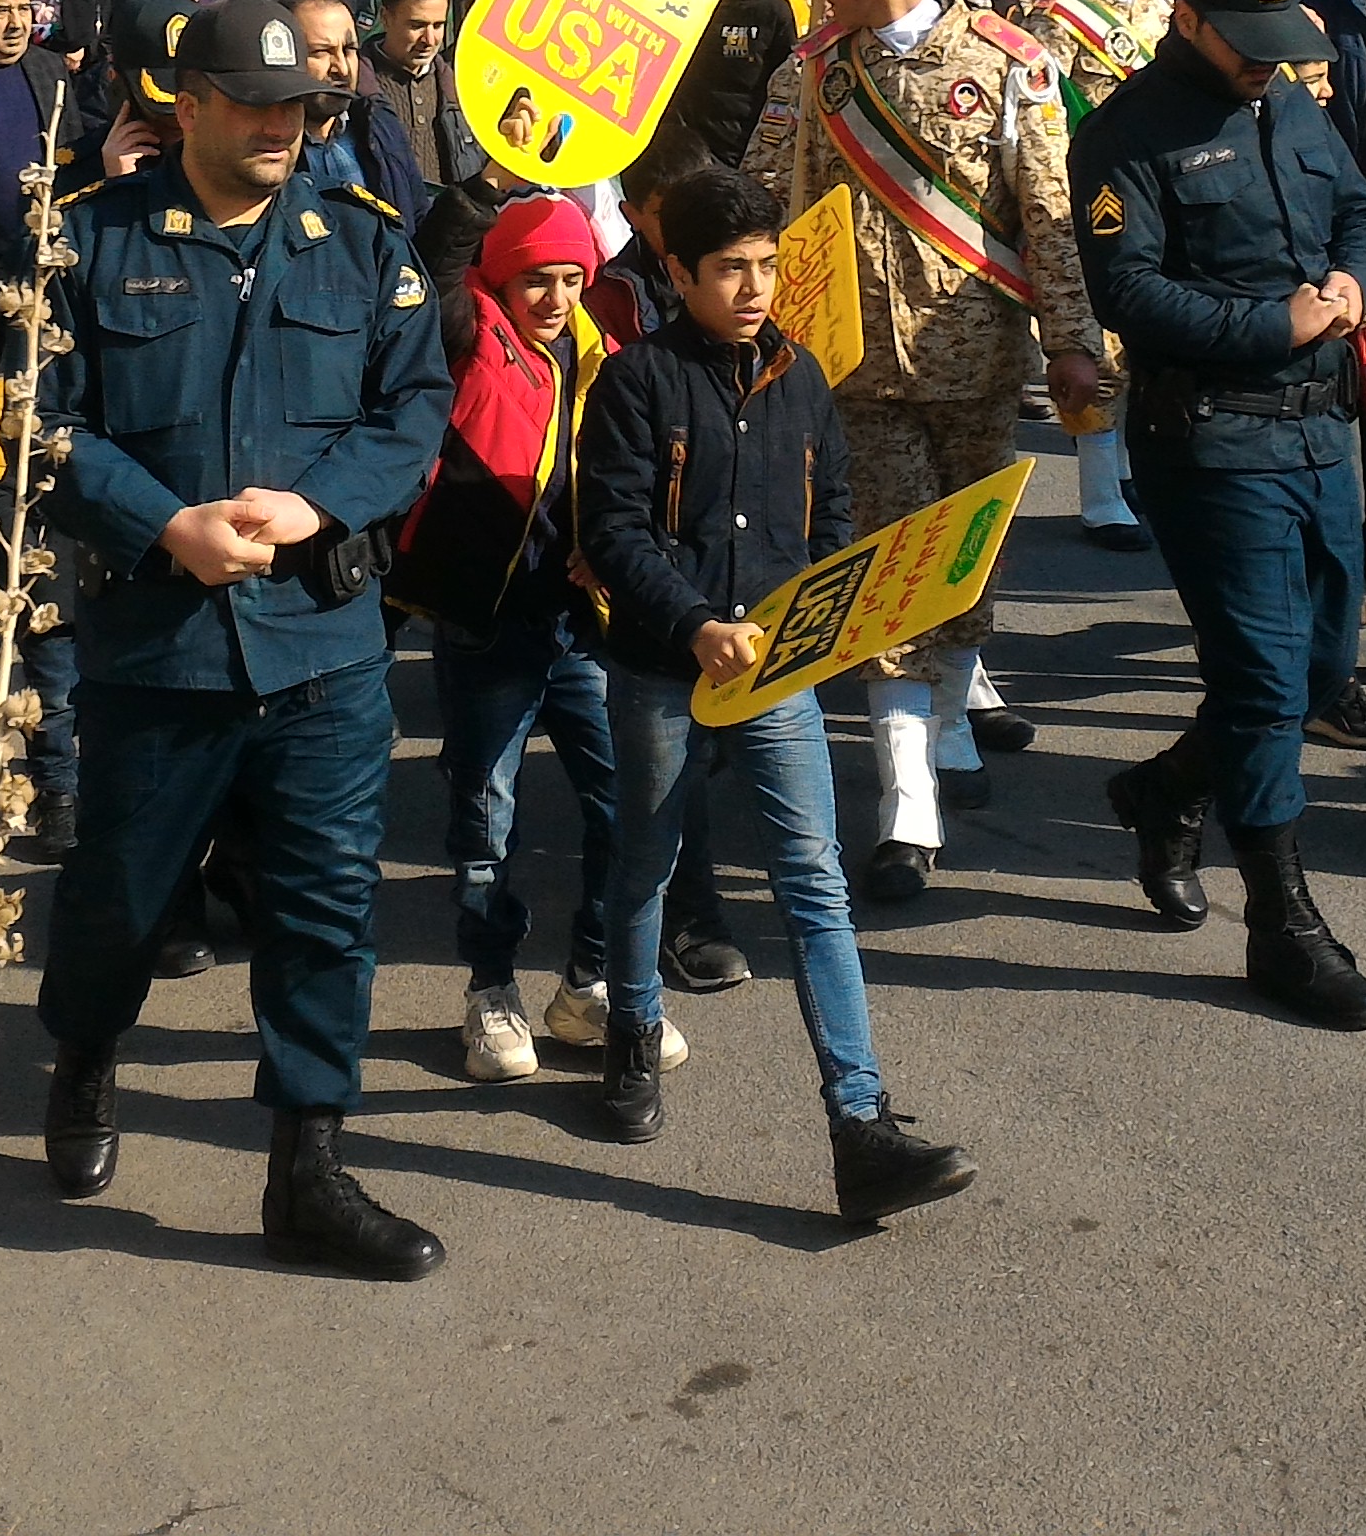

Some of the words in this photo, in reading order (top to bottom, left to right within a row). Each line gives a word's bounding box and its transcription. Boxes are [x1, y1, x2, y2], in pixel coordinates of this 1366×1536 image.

[605, 3, 667, 57] WITH
[836, 557, 868, 607] DOWN
[762, 565, 854, 679] USA
[814, 606, 847, 655] WITH
